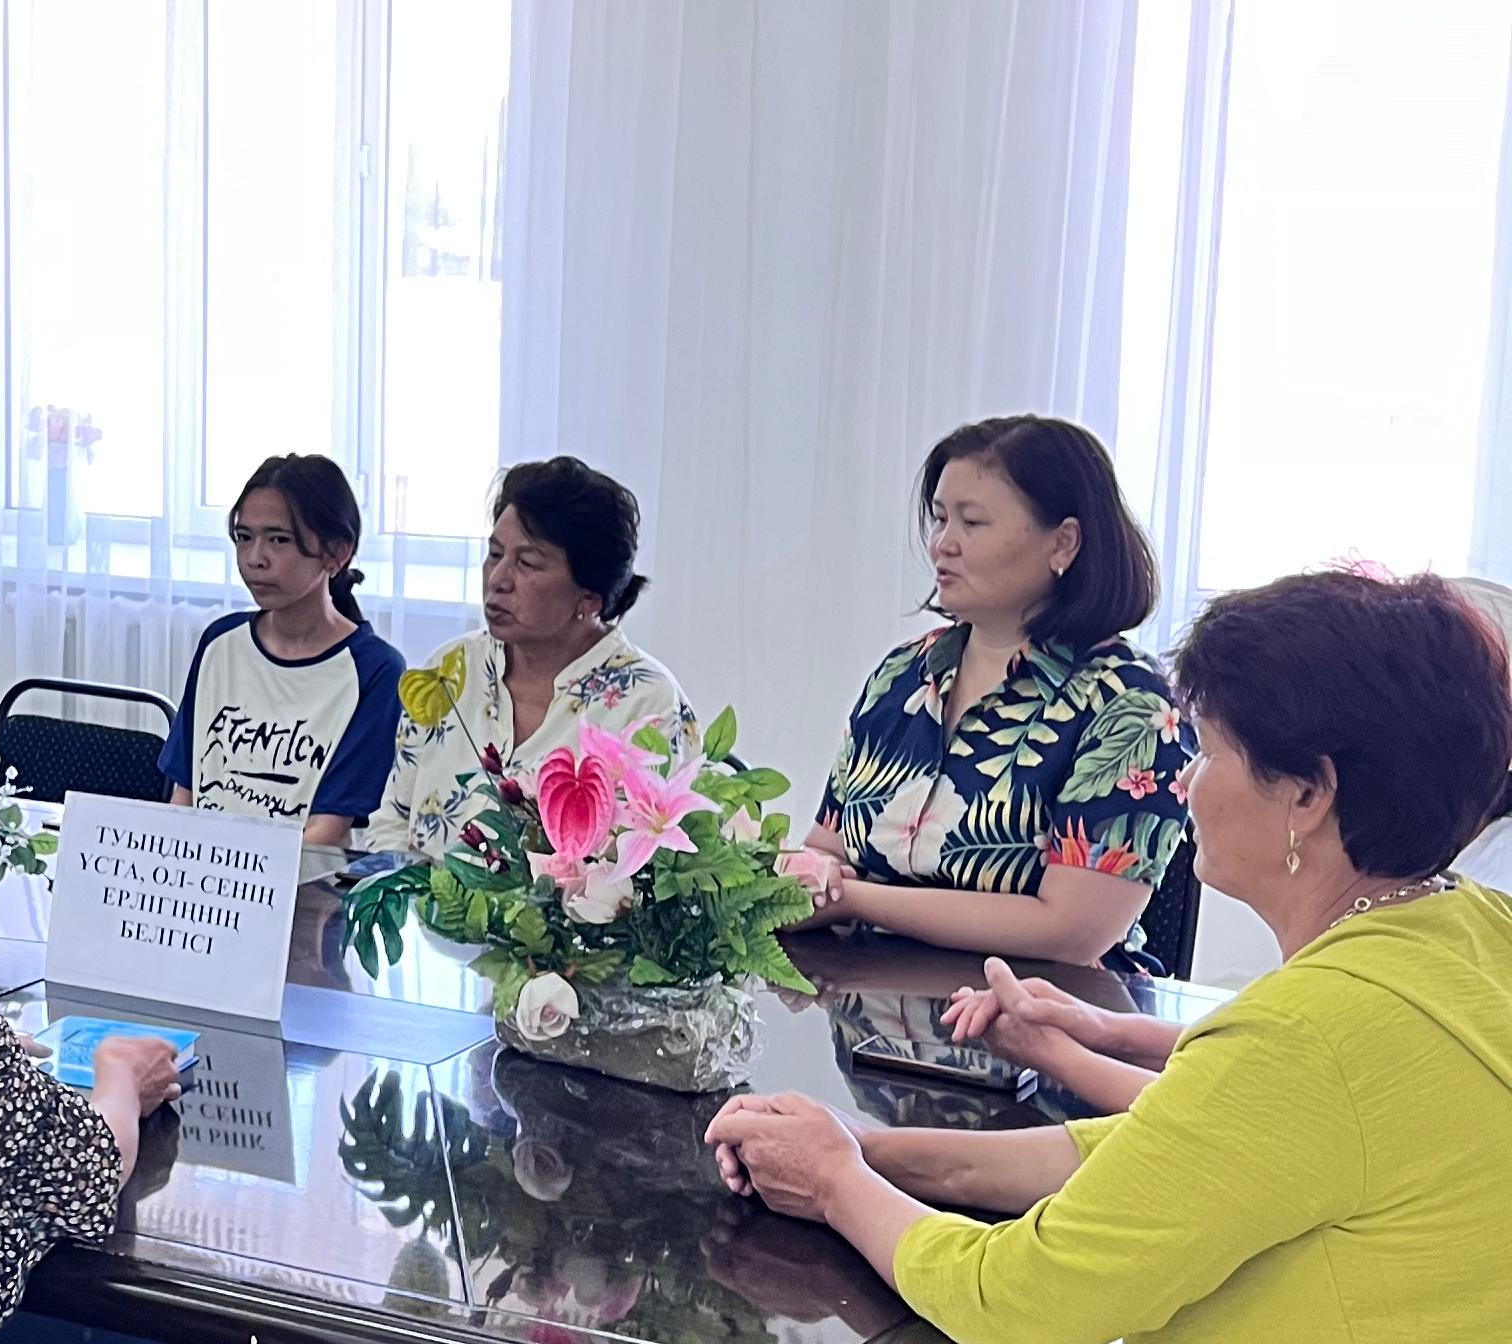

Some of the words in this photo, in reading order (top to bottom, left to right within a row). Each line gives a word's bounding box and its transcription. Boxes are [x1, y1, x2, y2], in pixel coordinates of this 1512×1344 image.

[96, 824, 202, 863] ТУЫҢДЫ
[210, 846, 269, 874] БИІК
[103, 886, 240, 935] ЕРЛІГІҢНІҢ
[152, 865, 194, 888] ОЛ-
[200, 874, 275, 911] СЕНІҢ
[120, 919, 213, 955] БЕЛГІСІ
